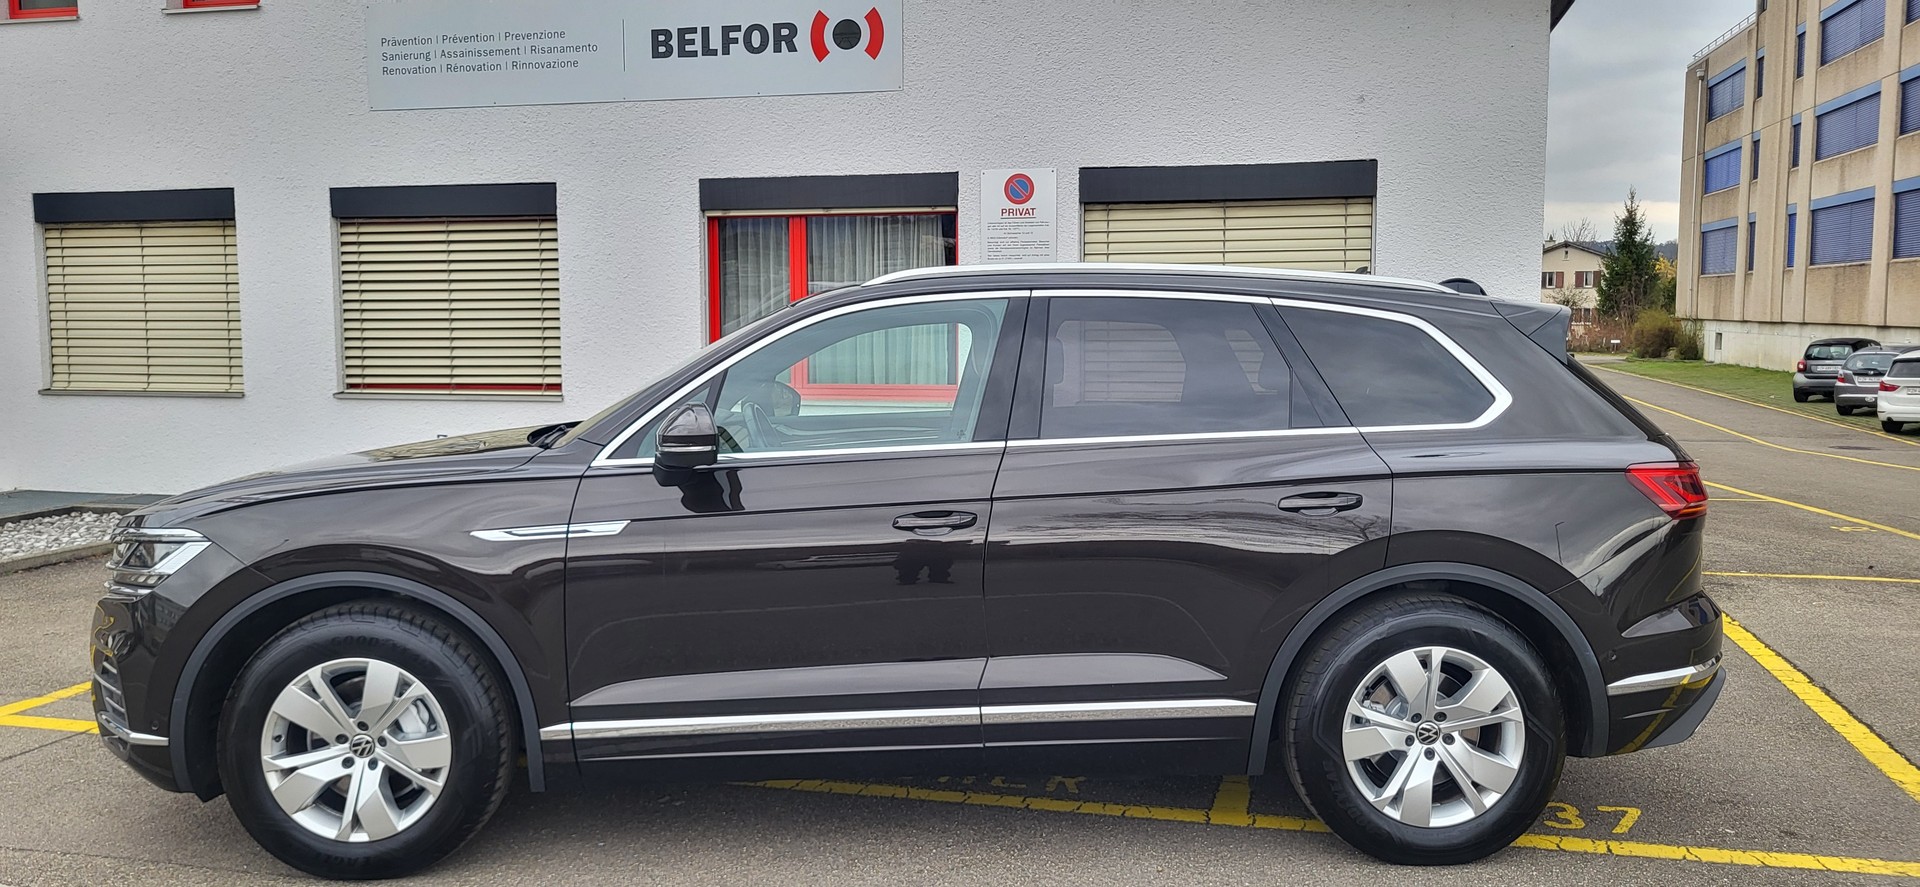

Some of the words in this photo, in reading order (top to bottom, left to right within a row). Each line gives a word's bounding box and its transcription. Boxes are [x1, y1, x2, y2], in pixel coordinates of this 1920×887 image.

[381, 36, 433, 47] Prävention
[442, 32, 495, 45] Prévention
[504, 29, 566, 41] Prevenzione
[651, 22, 799, 59] BELFOR
[382, 50, 432, 62] Sanierung
[440, 46, 521, 59] Assainissement
[530, 43, 598, 55] Risanamento
[382, 64, 437, 76] Renovation
[446, 61, 502, 73] Rénovation
[511, 58, 579, 70] Rinnovazione
[1001, 208, 1036, 217] PRIVAT
[1544, 802, 1642, 834] 37
